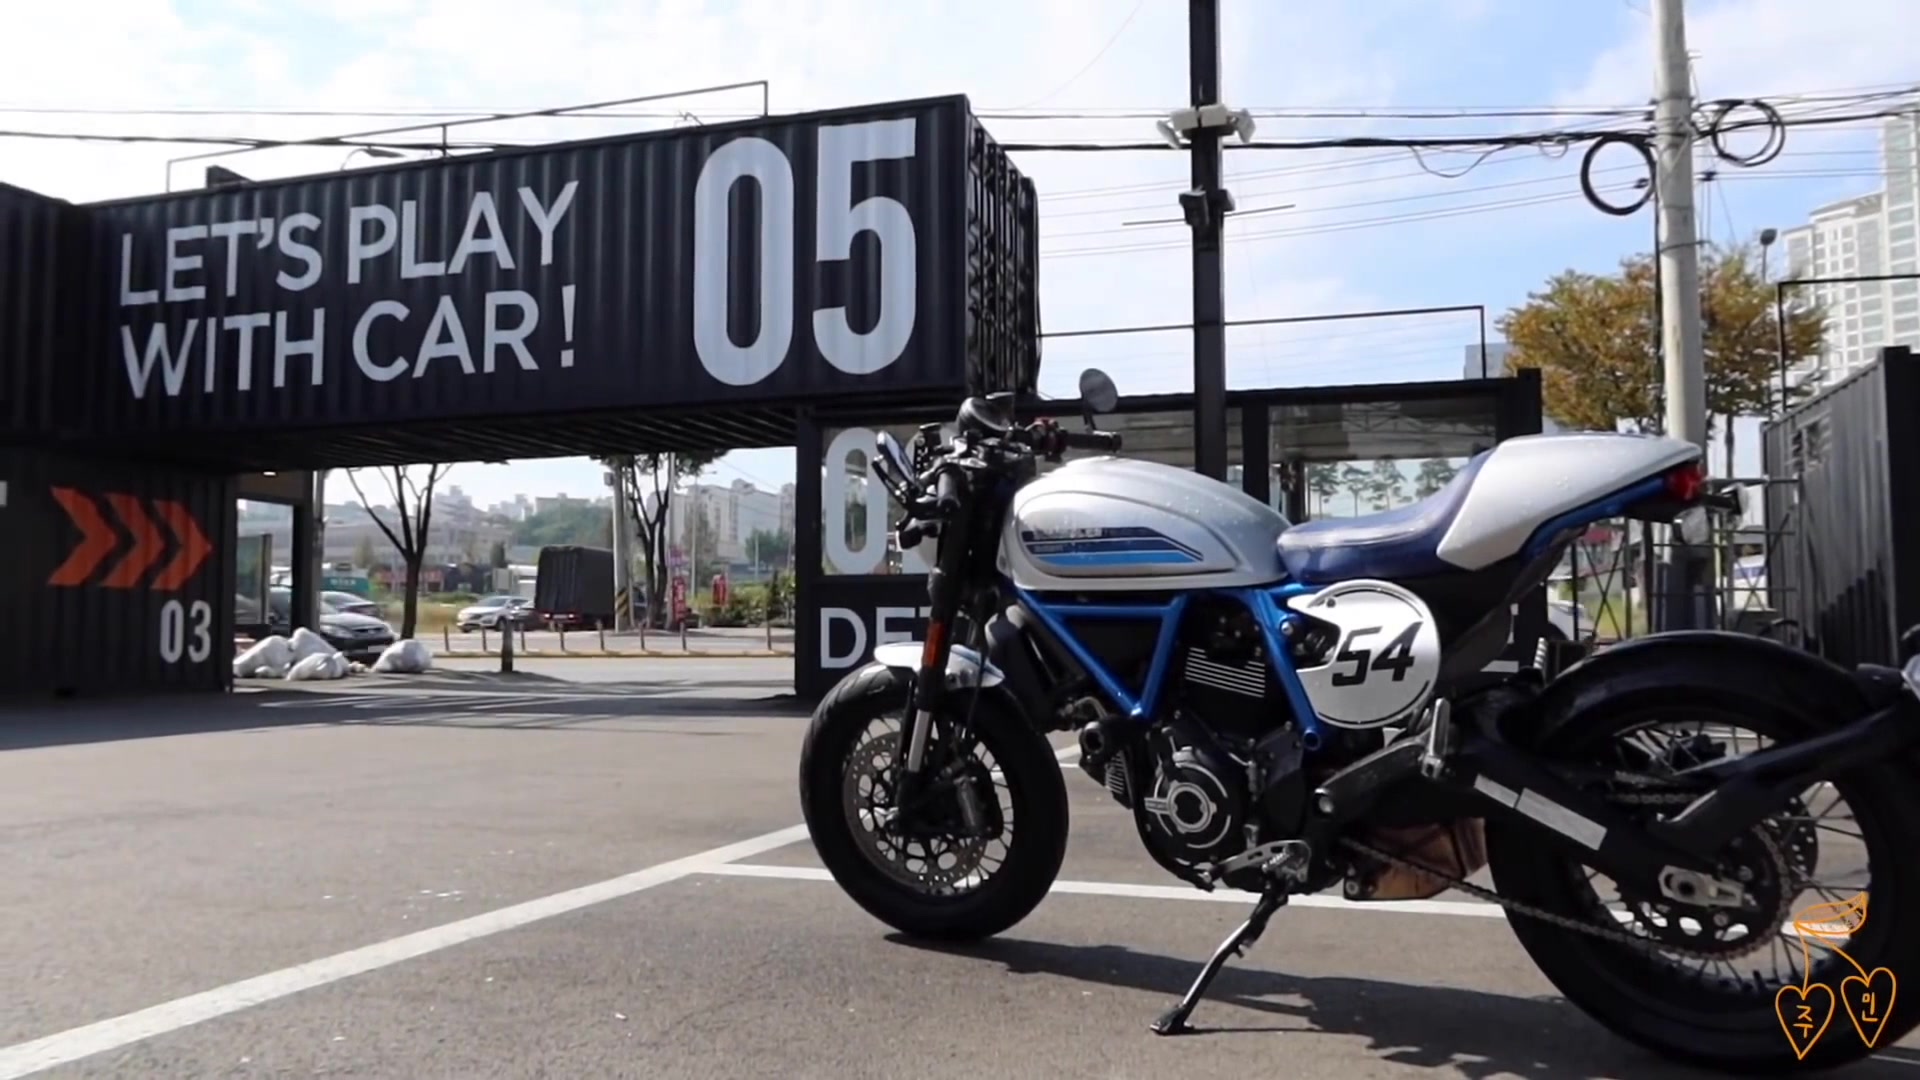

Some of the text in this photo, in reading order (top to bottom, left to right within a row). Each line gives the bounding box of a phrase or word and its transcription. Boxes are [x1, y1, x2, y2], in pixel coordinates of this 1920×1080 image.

[121, 181, 579, 305] LET'S PLAY
[694, 118, 916, 386] 05
[121, 307, 325, 398] WITH
[160, 599, 212, 663] 03
[1331, 621, 1424, 687] 54
